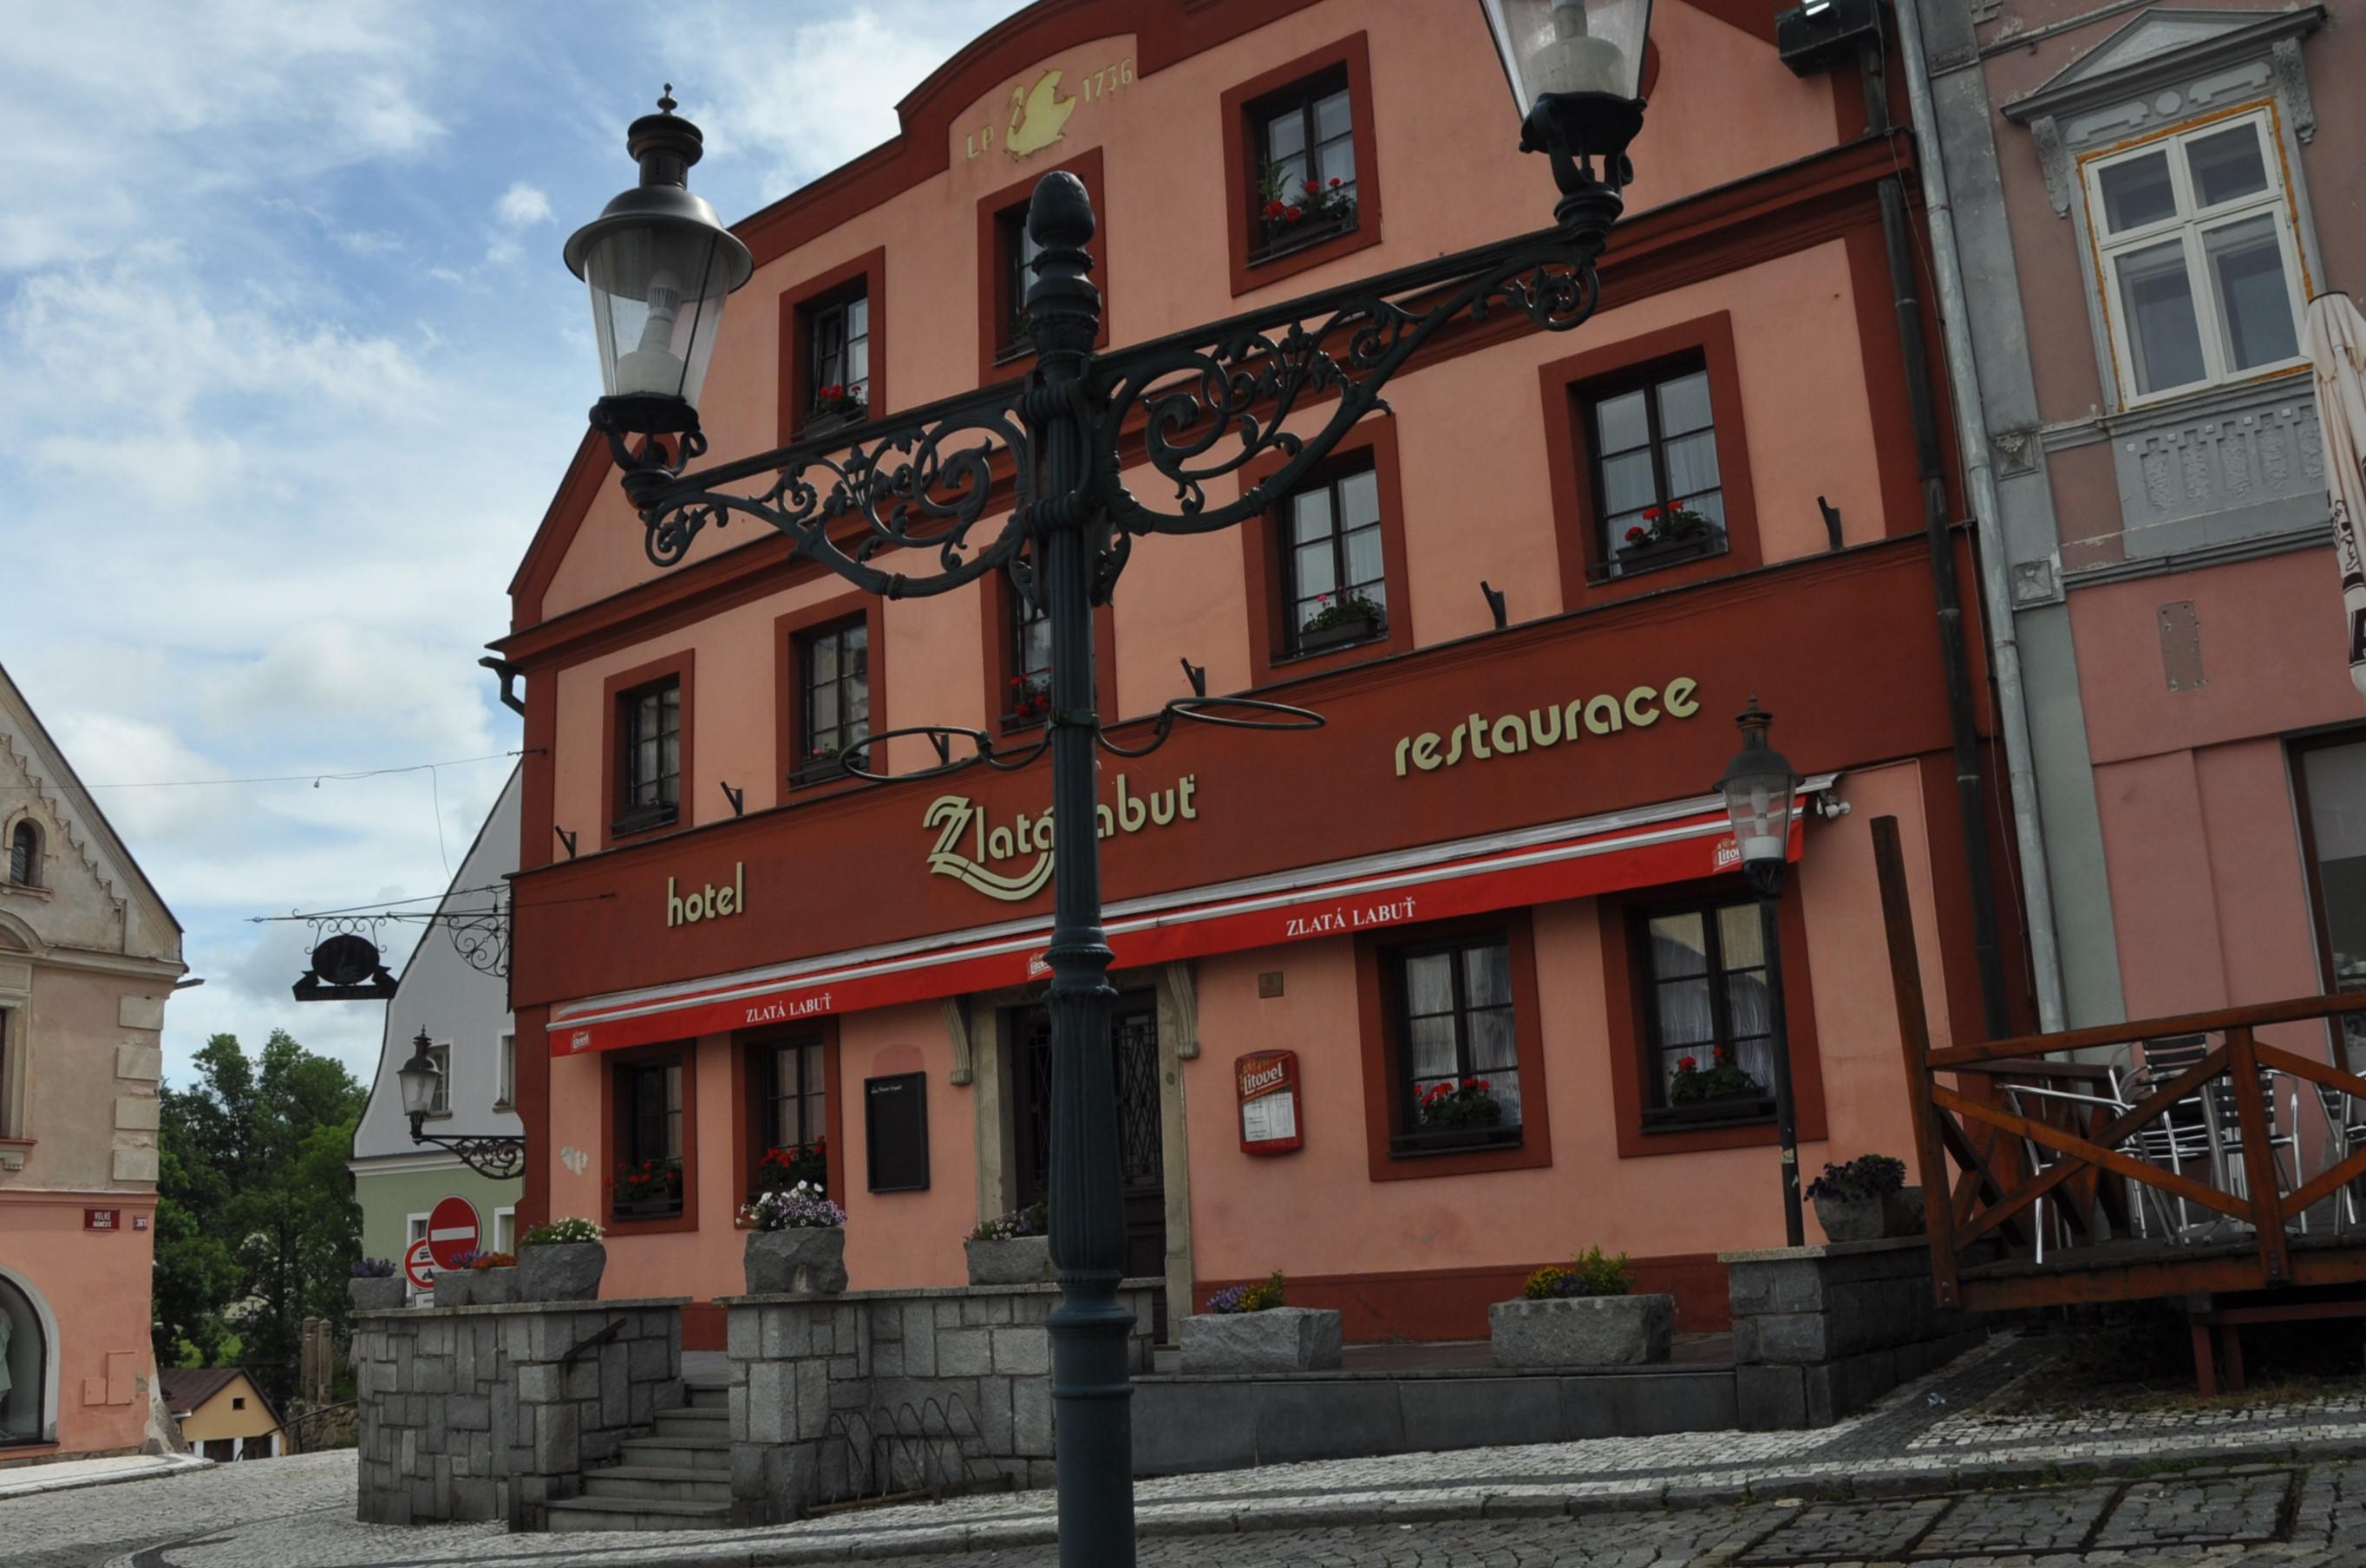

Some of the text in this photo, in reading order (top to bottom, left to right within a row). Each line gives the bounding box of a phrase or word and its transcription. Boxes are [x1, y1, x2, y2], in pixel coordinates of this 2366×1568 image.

[1082, 58, 1133, 102] 1736
[1395, 676, 1700, 777] restaurace
[667, 861, 743, 927] hotel
[1286, 896, 1415, 937] ZLATÁ LABUŤ
[746, 992, 832, 1023] ZLATÁ LABUŤ
[1243, 1061, 1284, 1096] Litovel
